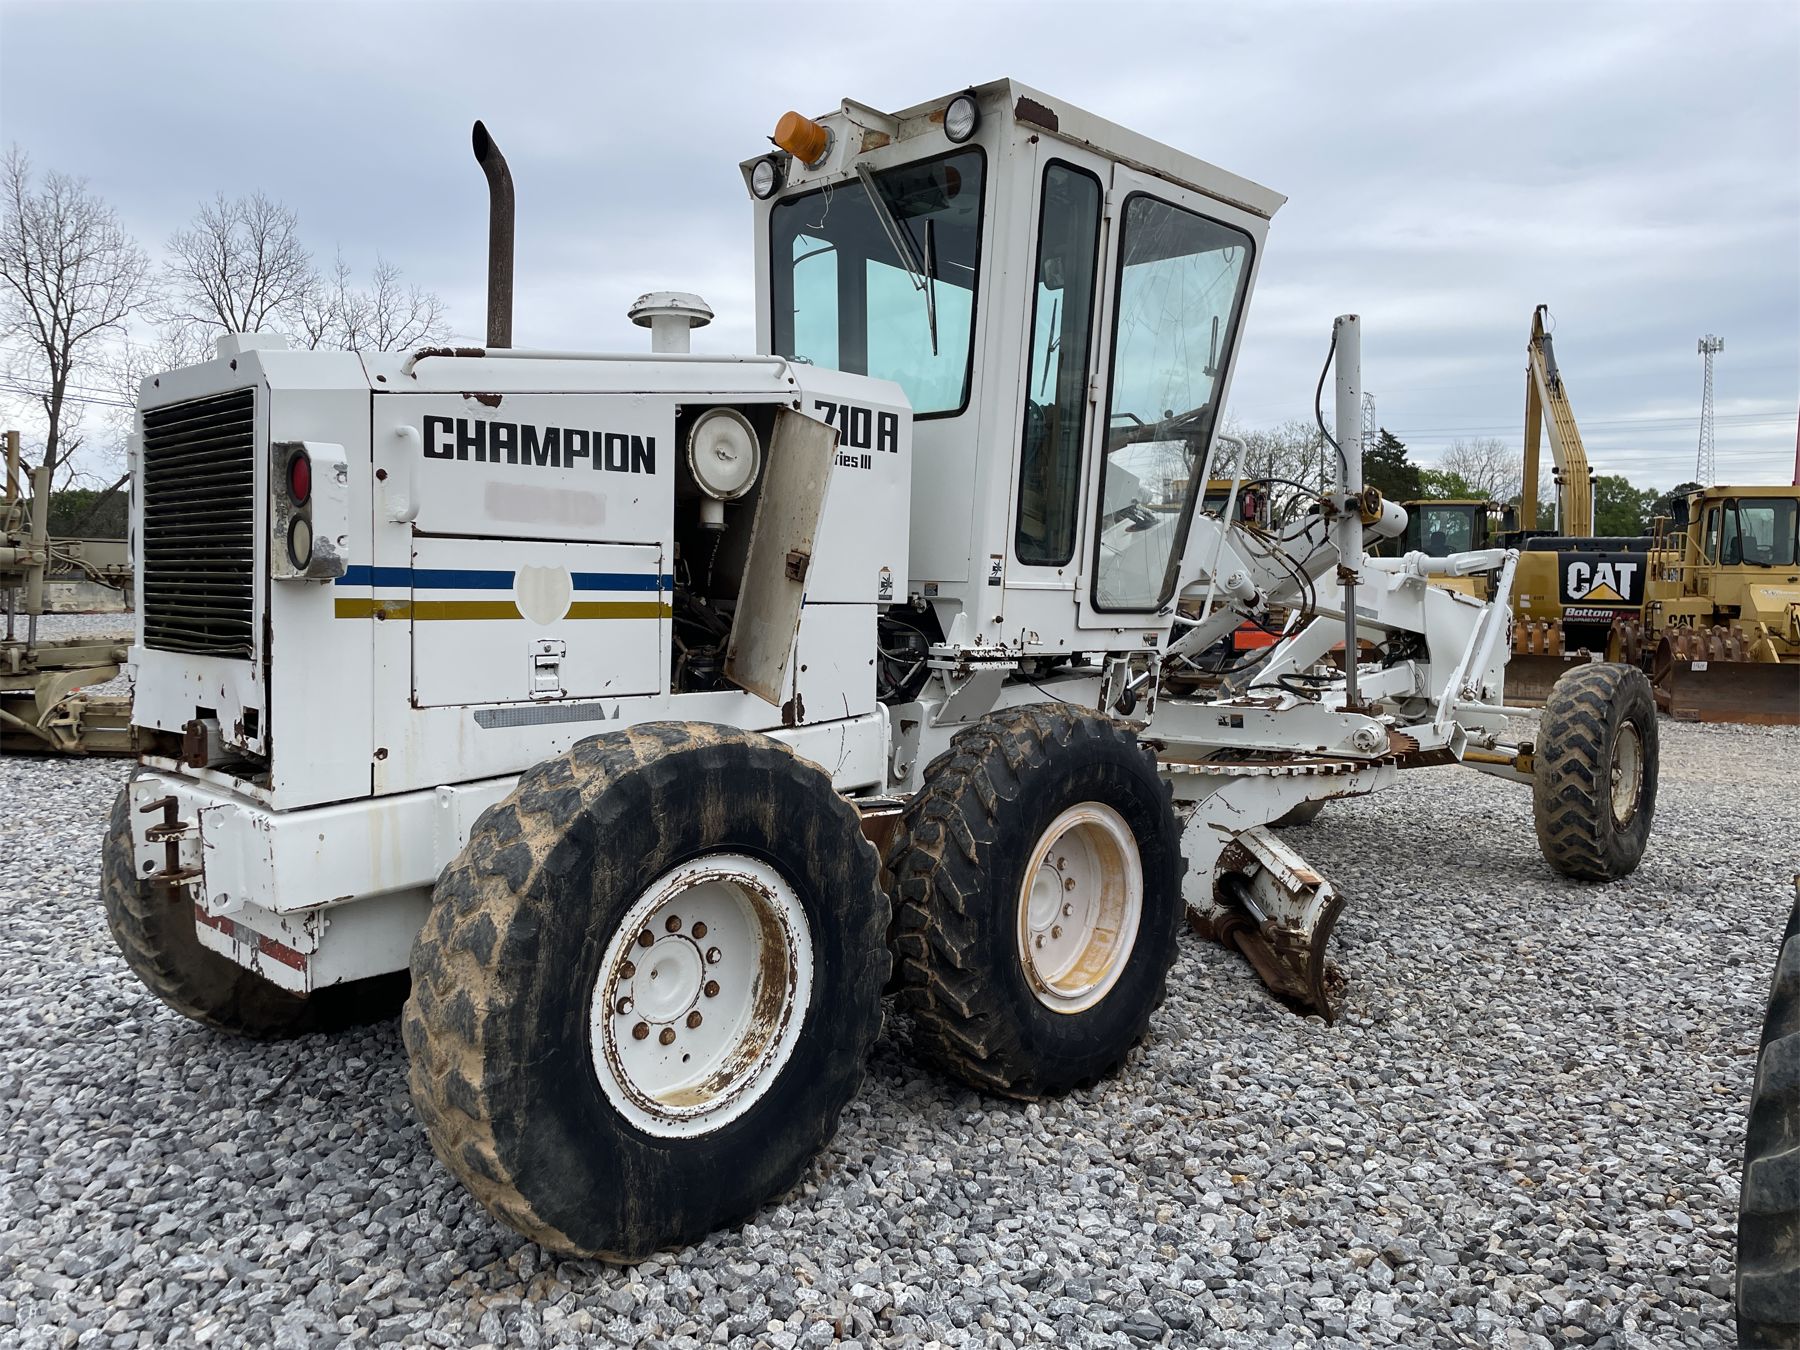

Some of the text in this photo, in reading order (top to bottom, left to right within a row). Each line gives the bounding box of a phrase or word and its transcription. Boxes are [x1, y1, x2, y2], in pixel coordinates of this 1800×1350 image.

[814, 400, 899, 453] 710 A
[423, 414, 657, 475] CHAMPION
[834, 451, 858, 468] ries
[1567, 561, 1638, 600] CAT
[1563, 616, 1600, 624] EQUIPMENT
[1564, 607, 1614, 618] Bottom
[1668, 614, 1697, 629] CAT
